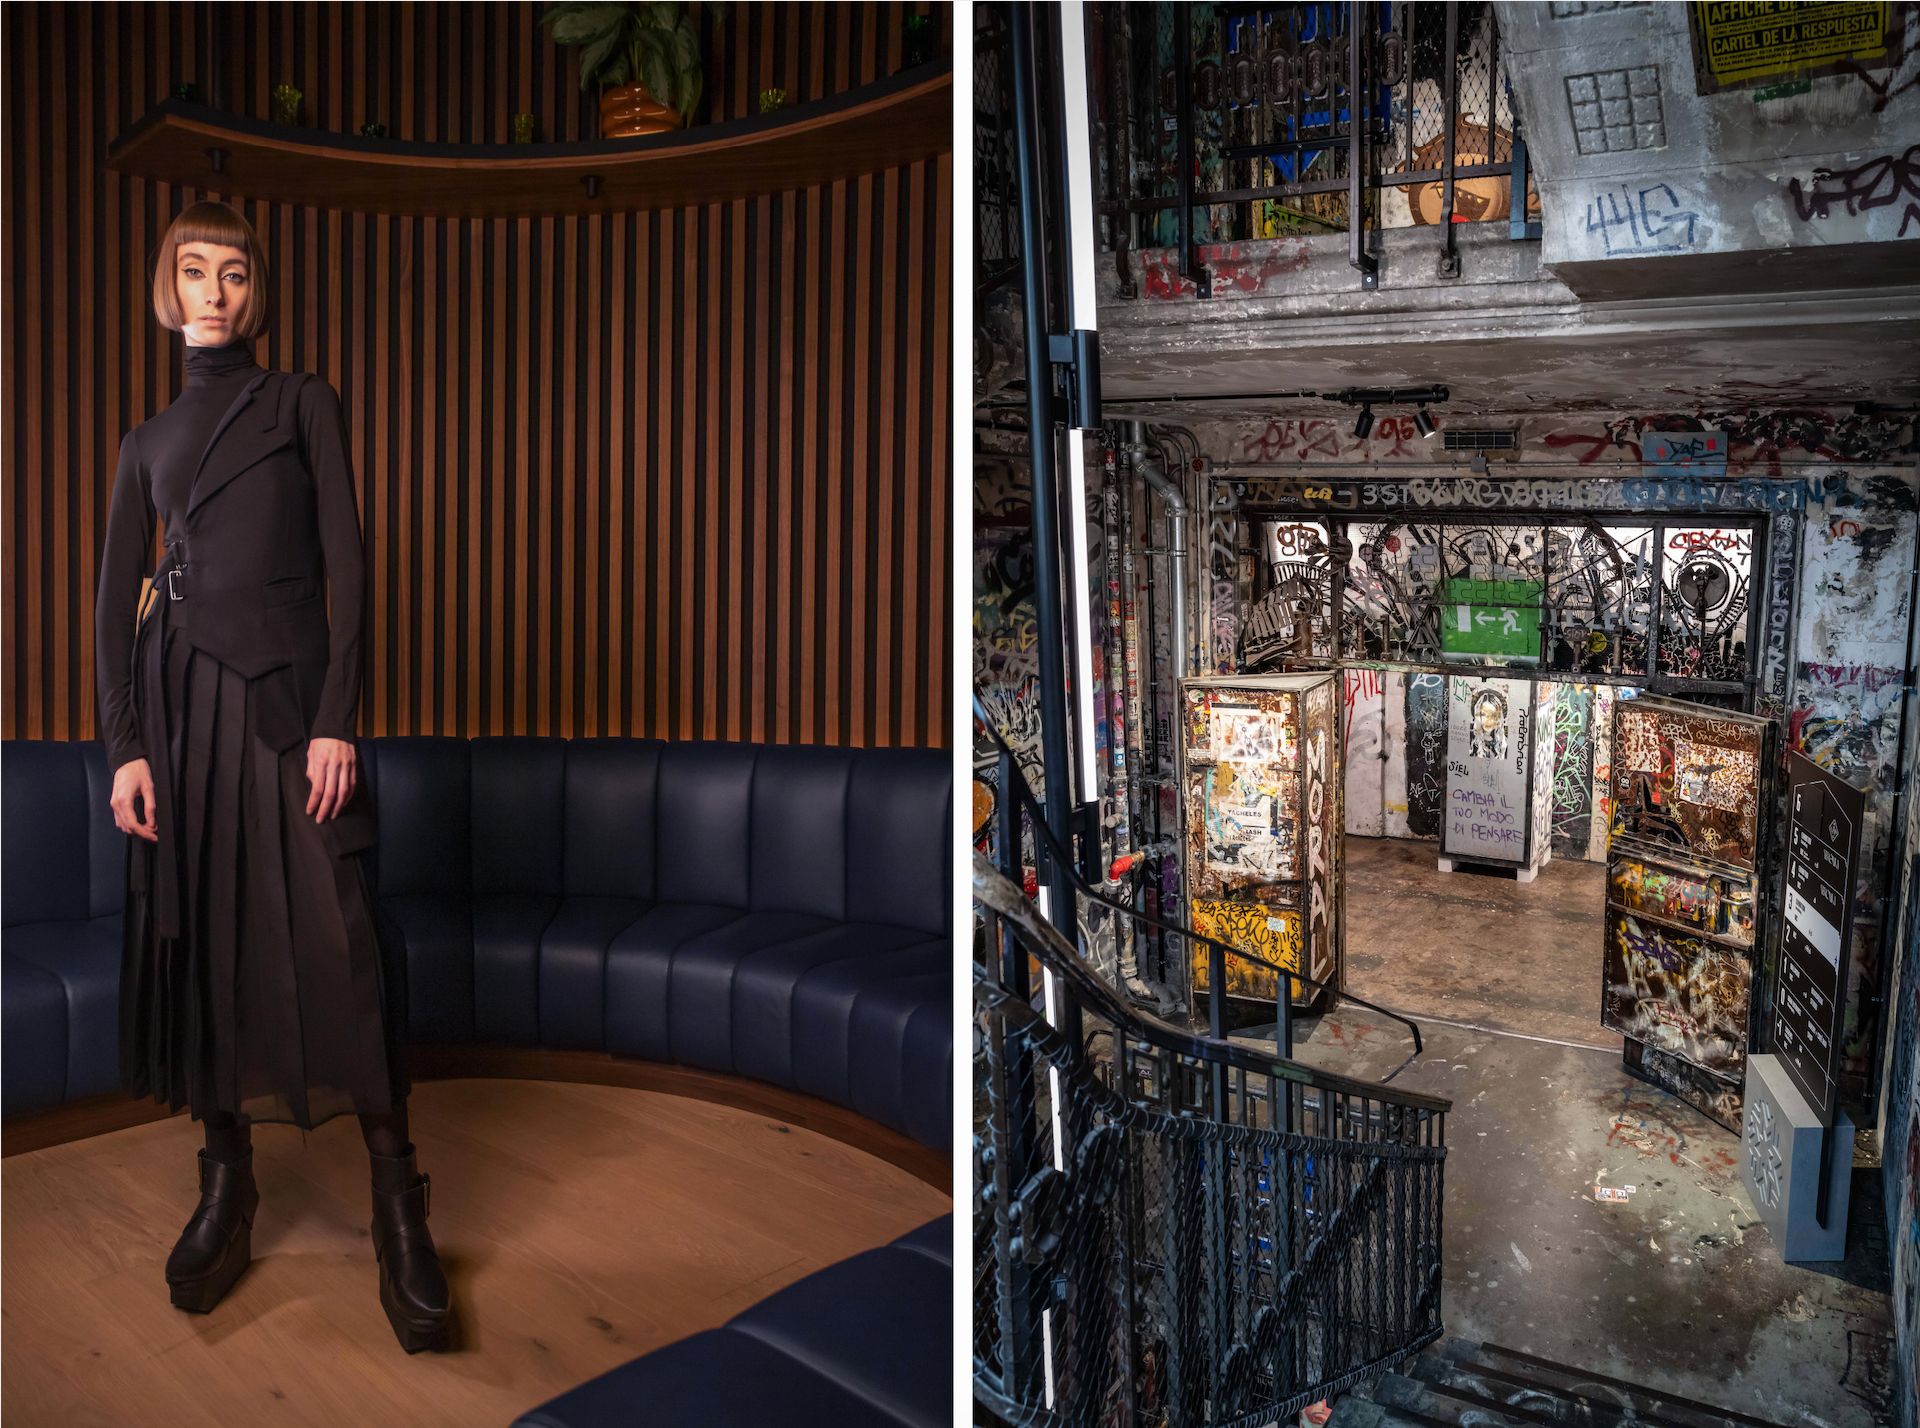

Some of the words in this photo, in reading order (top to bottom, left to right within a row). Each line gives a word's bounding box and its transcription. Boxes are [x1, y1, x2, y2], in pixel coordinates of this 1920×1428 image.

[1711, 1, 1774, 23] AFFICHE
[1712, 32, 1760, 54] CARTEL
[1762, 28, 1779, 46] DE
[1782, 25, 1799, 42] LA
[1802, 13, 1876, 39] RESPUESTA
[1453, 789, 1495, 807] CAMBIA
[1500, 794, 1515, 809] IL
[1795, 793, 1802, 812] 6
[1453, 807, 1472, 818] TUO
[1454, 822, 1464, 835] DI
[1472, 823, 1523, 844] PENSARE
[1793, 827, 1799, 845] 5
[1790, 860, 1797, 879] 4
[1788, 893, 1793, 910] 3
[1785, 924, 1791, 942] 2
[1783, 957, 1788, 974] 1
[1780, 987, 1786, 1006] 0
